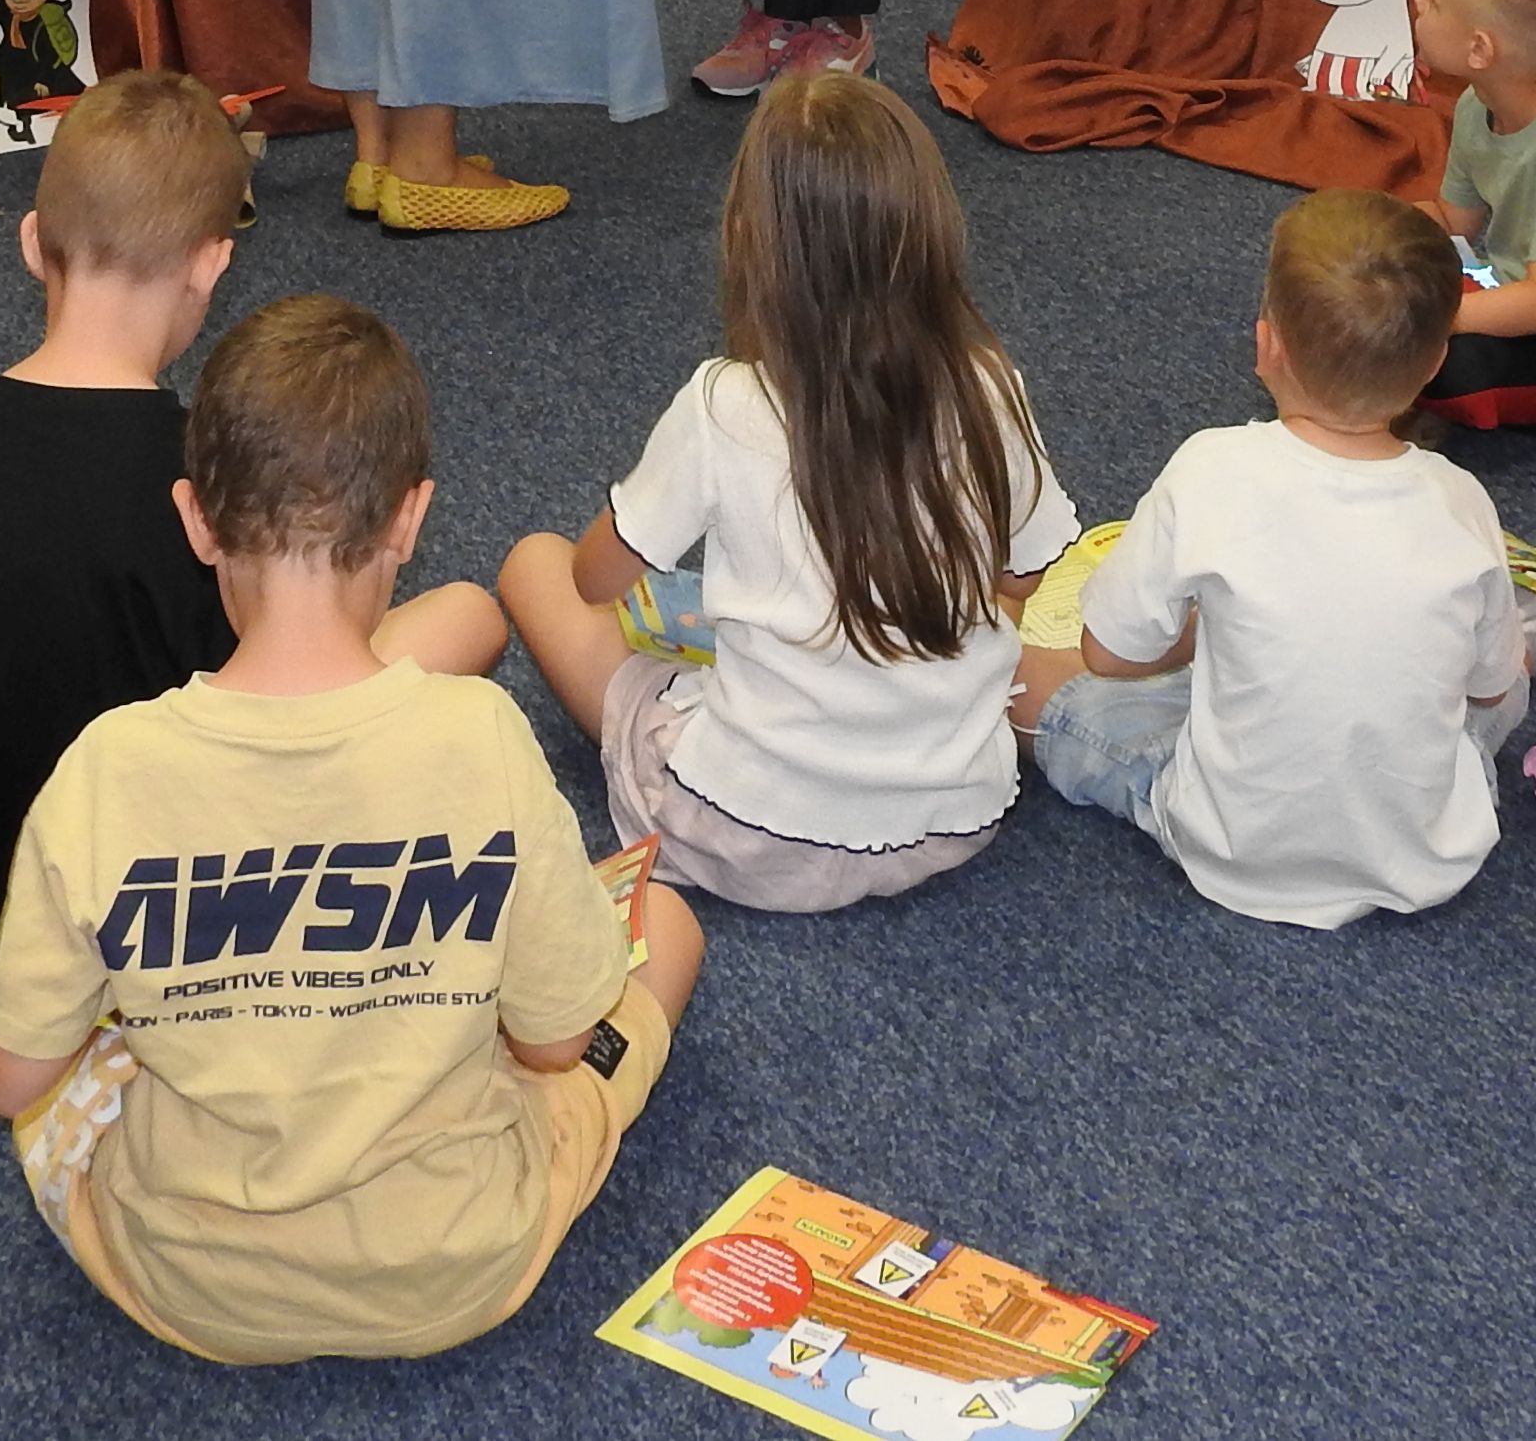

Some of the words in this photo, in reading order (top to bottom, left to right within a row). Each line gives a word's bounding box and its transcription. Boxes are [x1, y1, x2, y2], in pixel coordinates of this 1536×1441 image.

[96, 830, 517, 971] AWSM
[163, 970, 284, 1000] POSITIVE
[291, 970, 365, 989] VIBES
[370, 959, 435, 984] ONLY
[175, 1005, 233, 1024] PARIS
[252, 1004, 312, 1018] TOKYO
[329, 992, 448, 1018] WORLDWIDE
